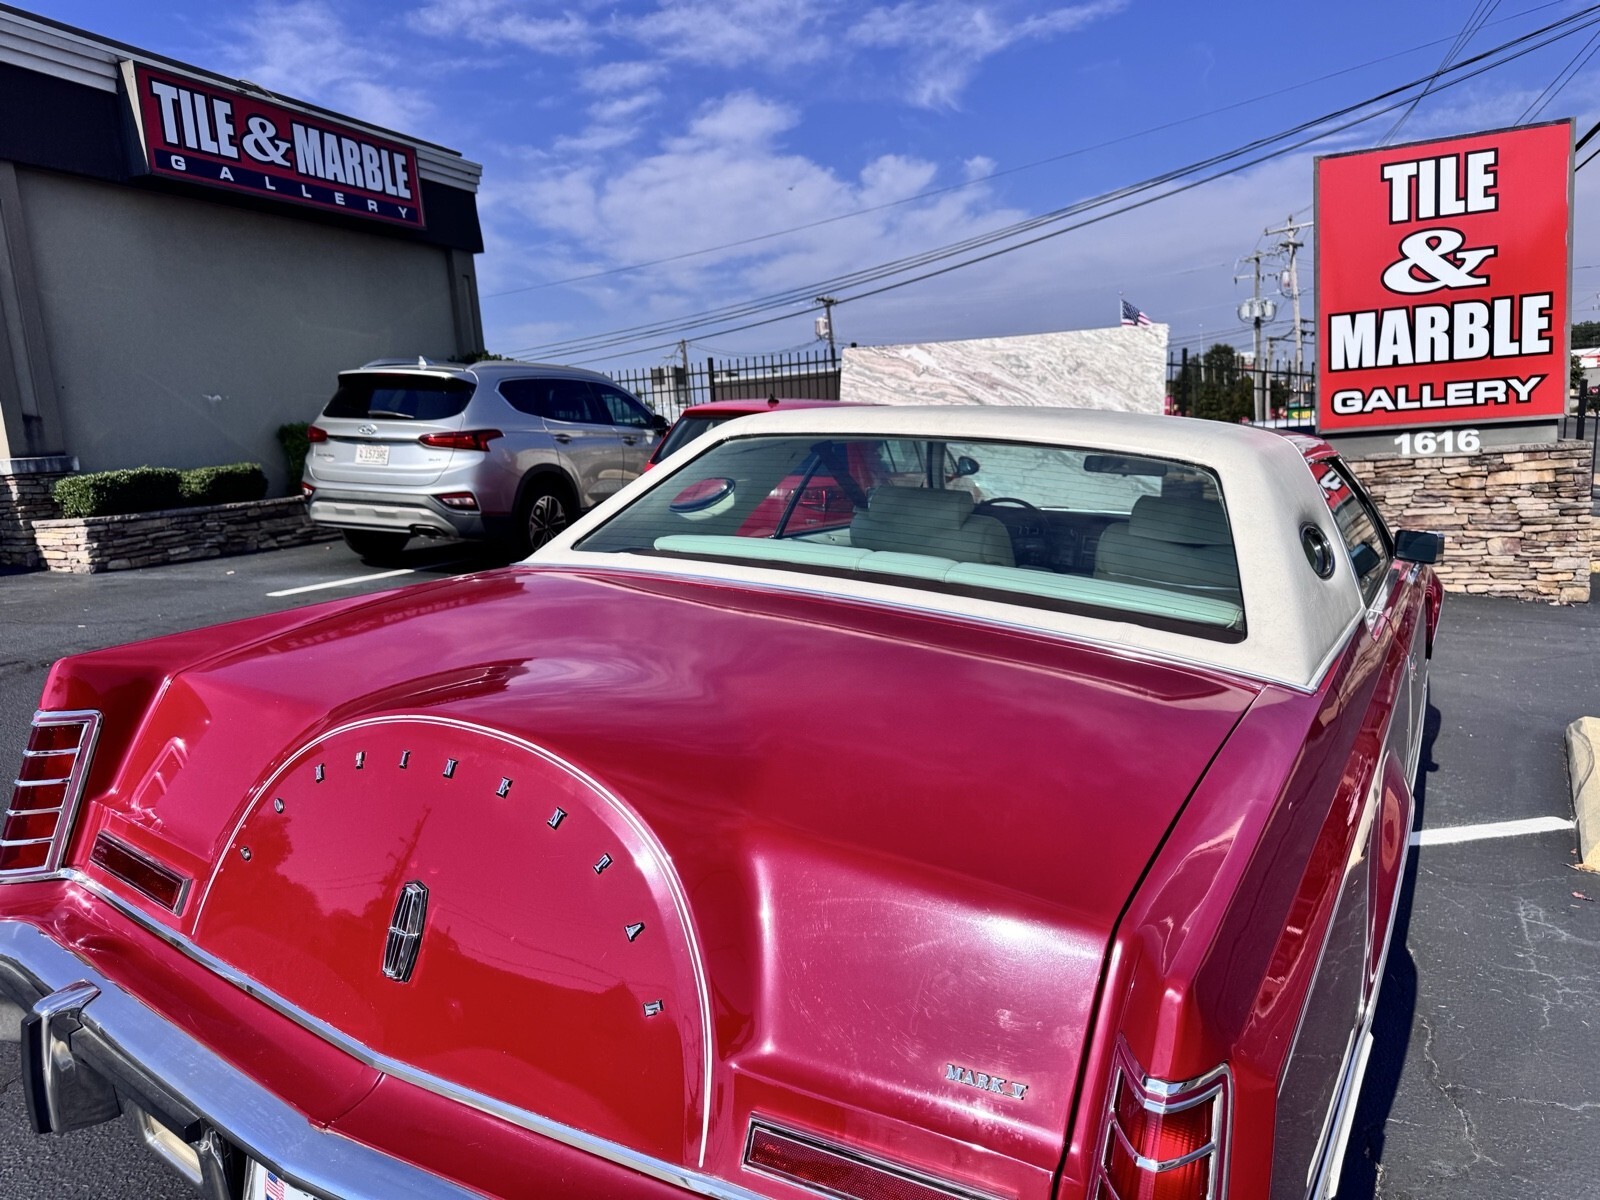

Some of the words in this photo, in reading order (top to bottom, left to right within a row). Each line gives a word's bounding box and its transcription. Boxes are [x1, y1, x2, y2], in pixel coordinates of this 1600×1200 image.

[151, 80, 239, 159] TILE
[242, 116, 291, 167] &
[292, 122, 411, 199] MARBLE
[170, 154, 408, 219] GALLERY
[1383, 150, 1496, 222] TILE
[1383, 229, 1495, 293] &
[1331, 295, 1550, 370] MARBLE
[1333, 377, 1542, 414] GALLERY
[1394, 429, 1480, 455] 1616
[945, 1063, 1006, 1094] MARK
[1011, 1082, 1028, 1100] V
